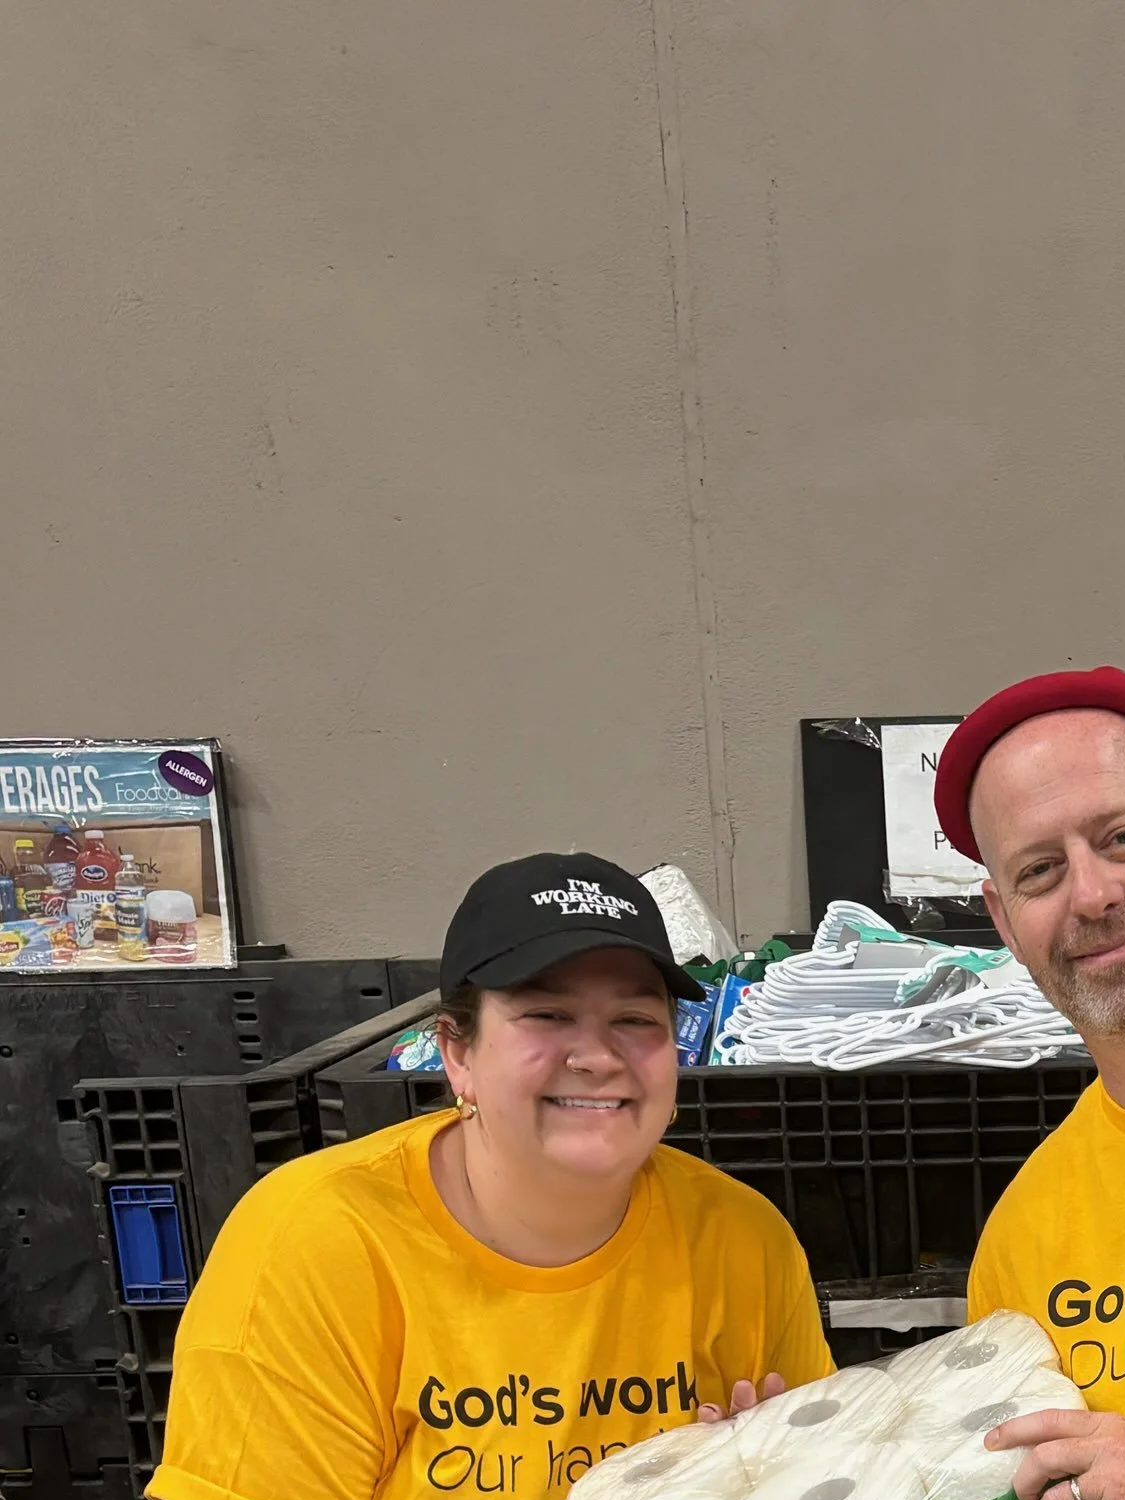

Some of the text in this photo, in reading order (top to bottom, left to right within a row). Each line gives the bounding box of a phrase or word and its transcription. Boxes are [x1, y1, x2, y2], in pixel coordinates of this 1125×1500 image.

[165, 759, 207, 788] ALLERGEN
[934, 830, 956, 850] P
[567, 879, 603, 896] I'M
[531, 889, 639, 916] WORKING
[559, 902, 621, 919] LATE
[419, 1374, 564, 1429] God's
[427, 1445, 523, 1492] Our
